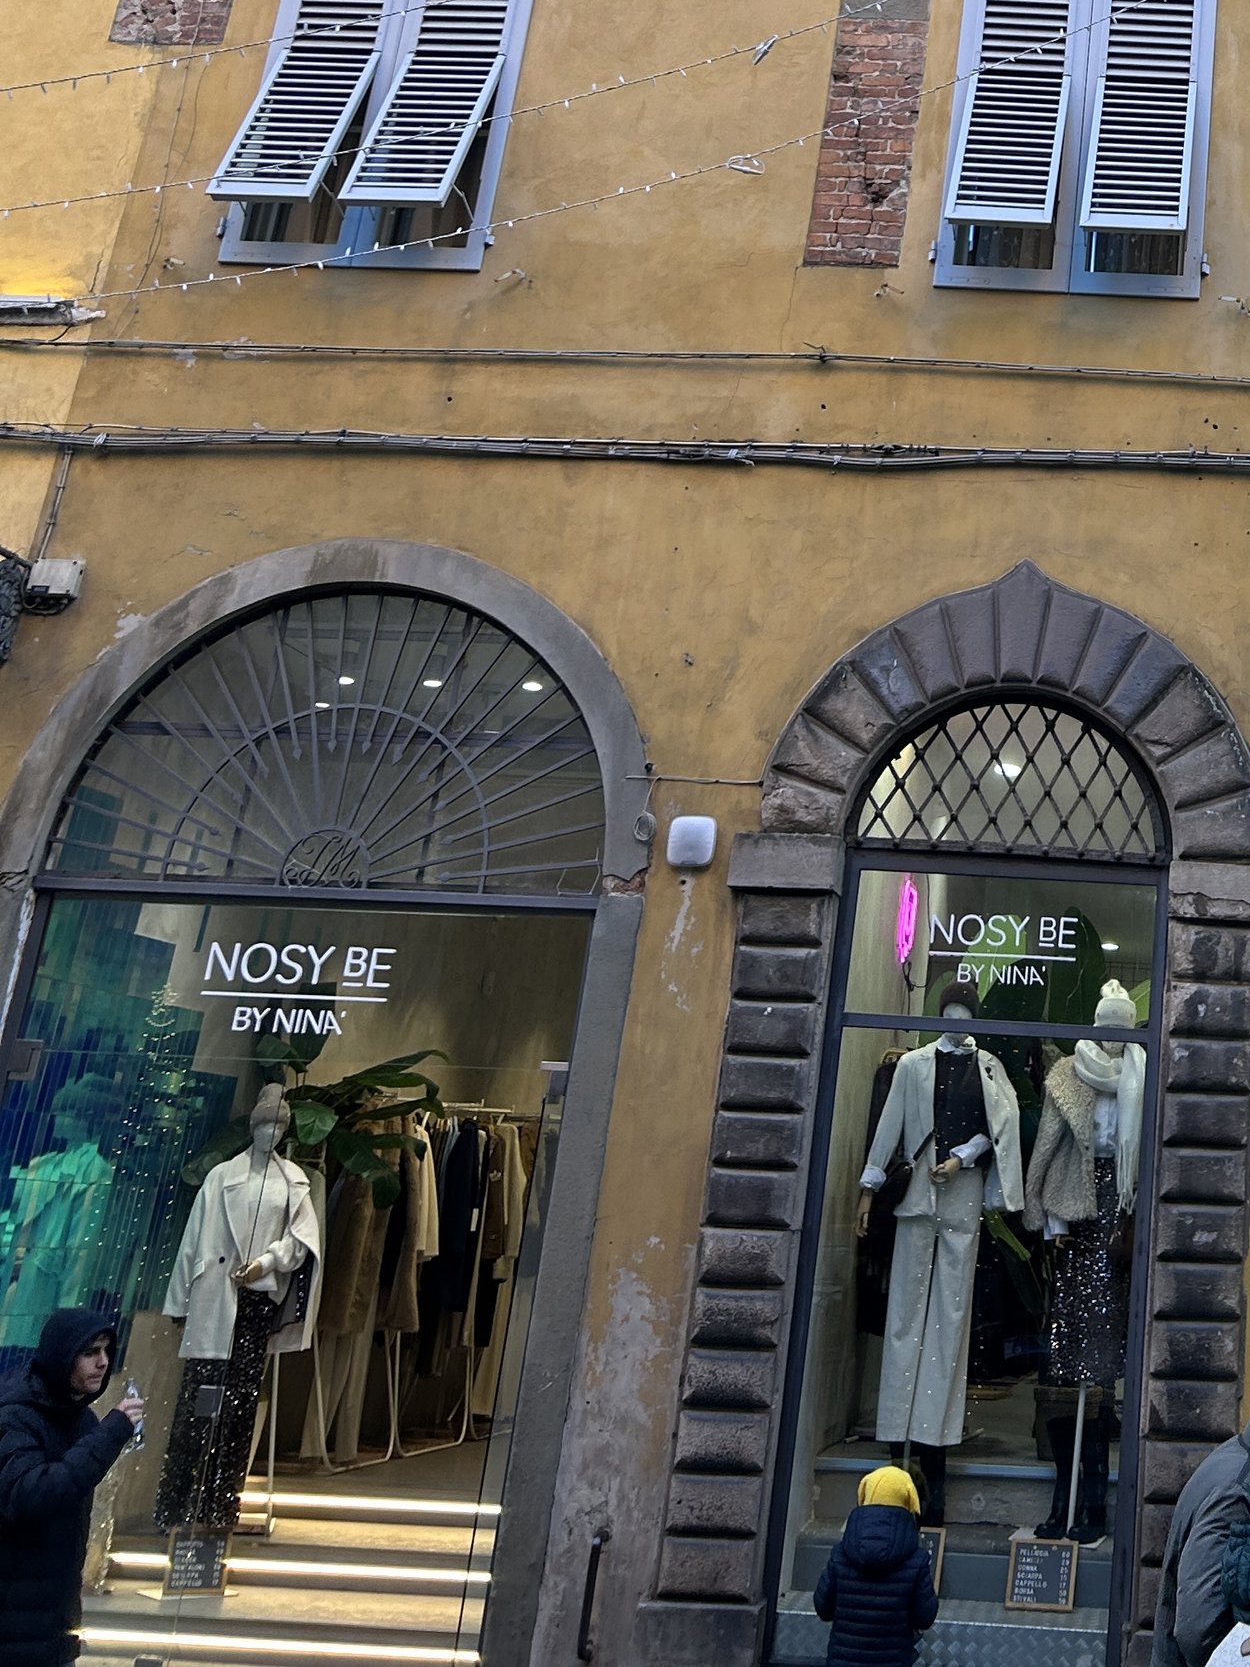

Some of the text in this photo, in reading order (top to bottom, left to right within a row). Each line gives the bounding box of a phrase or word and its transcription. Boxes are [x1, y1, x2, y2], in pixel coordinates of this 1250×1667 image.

[930, 913, 1079, 949] NOSY BE
[204, 941, 398, 988] NOSY BE
[956, 963, 986, 983] BY
[231, 1006, 272, 1032] BY
[1014, 1579, 1048, 1589] CAPPELLO
